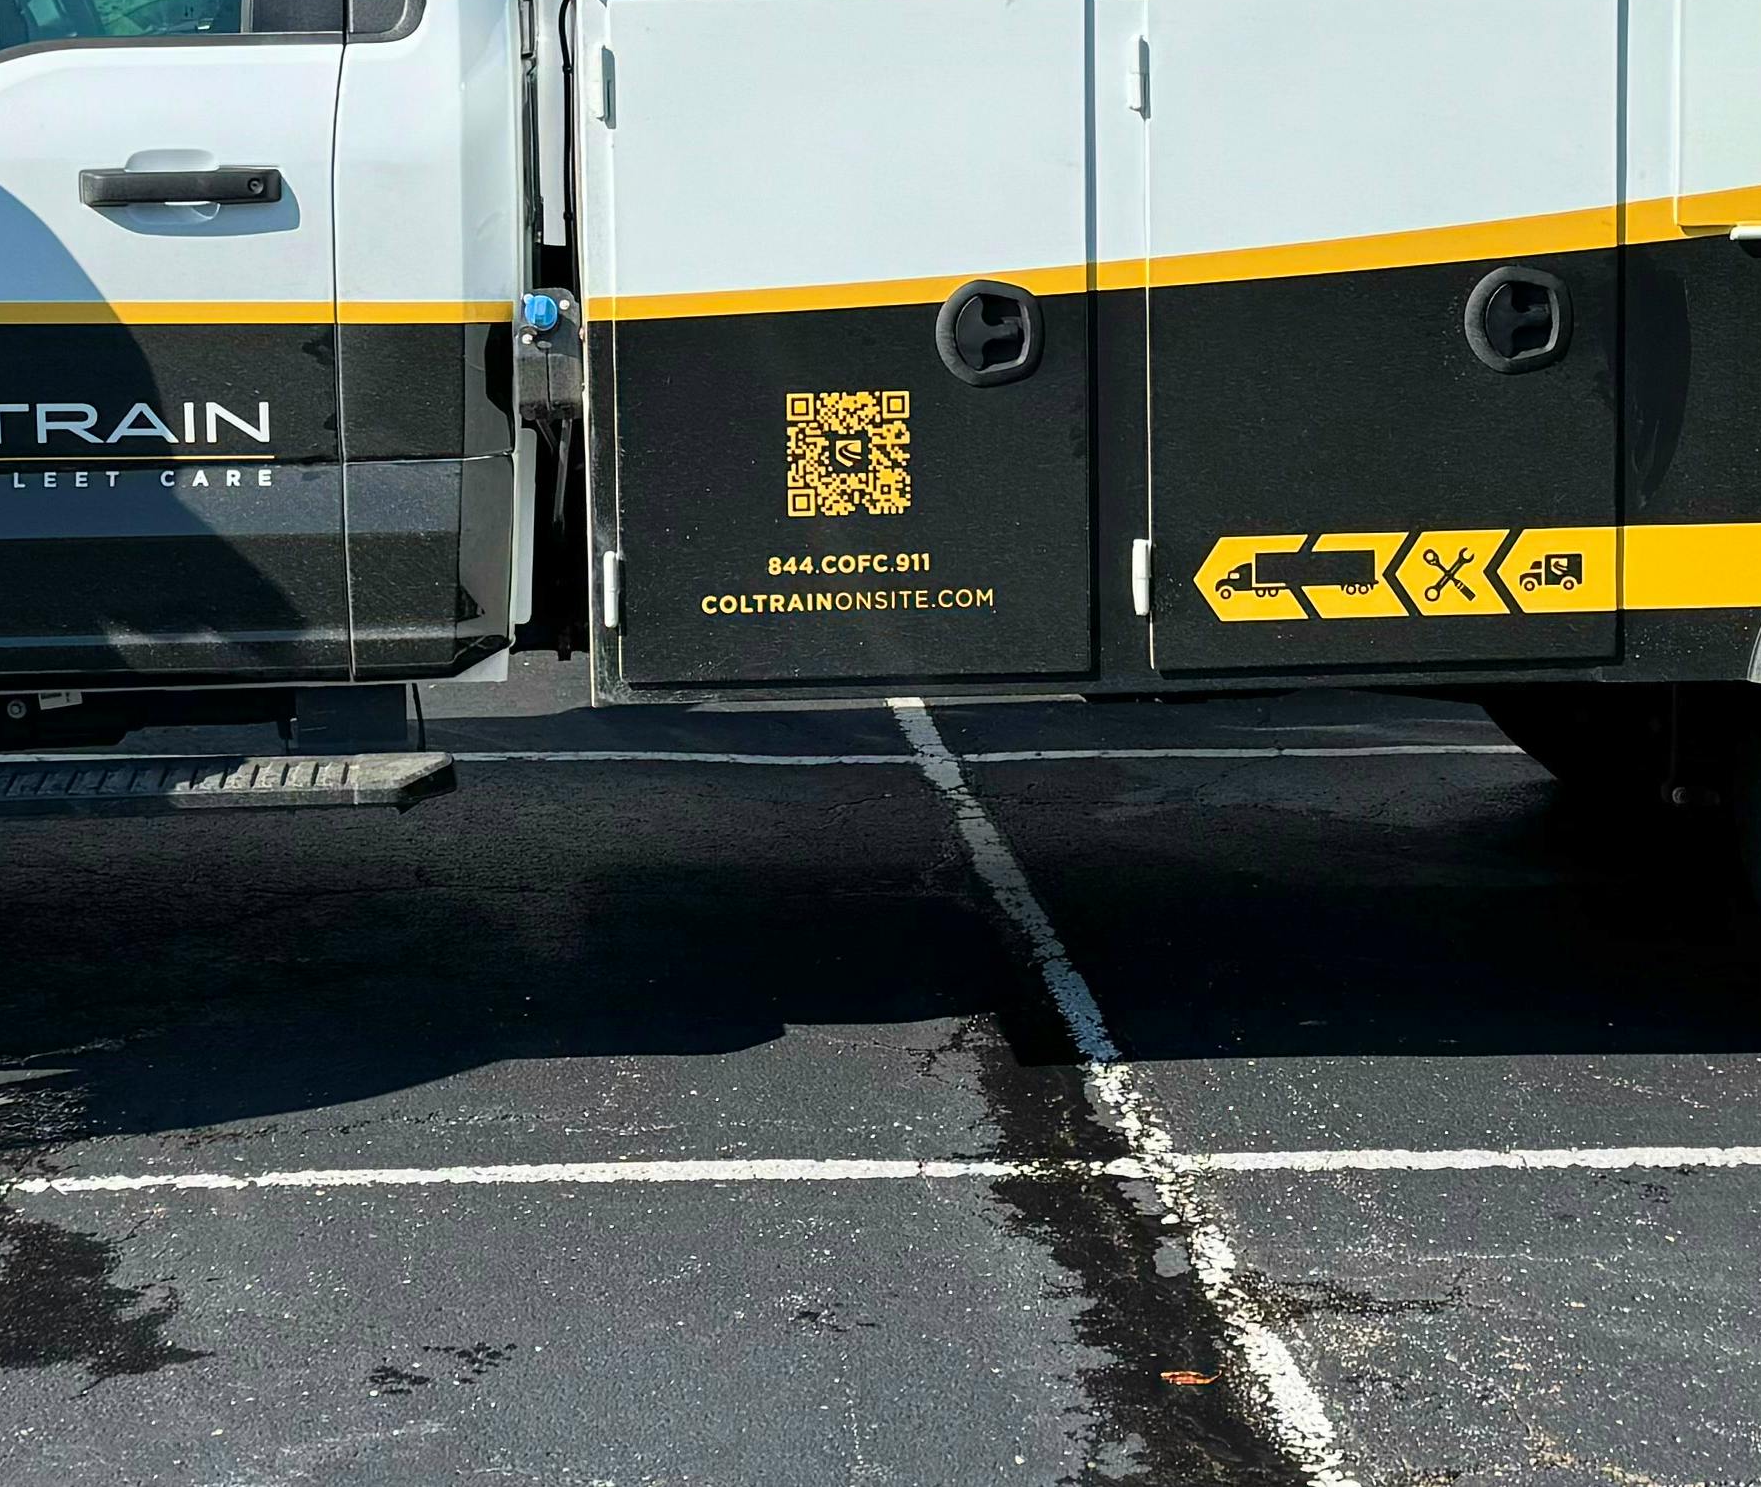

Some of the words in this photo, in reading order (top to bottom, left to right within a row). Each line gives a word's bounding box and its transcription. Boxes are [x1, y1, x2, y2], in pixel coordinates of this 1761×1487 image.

[160, 469, 273, 488] CARE
[767, 553, 930, 576] 844.COFC.911
[701, 588, 994, 614] COLTRAINONSITE.COM
